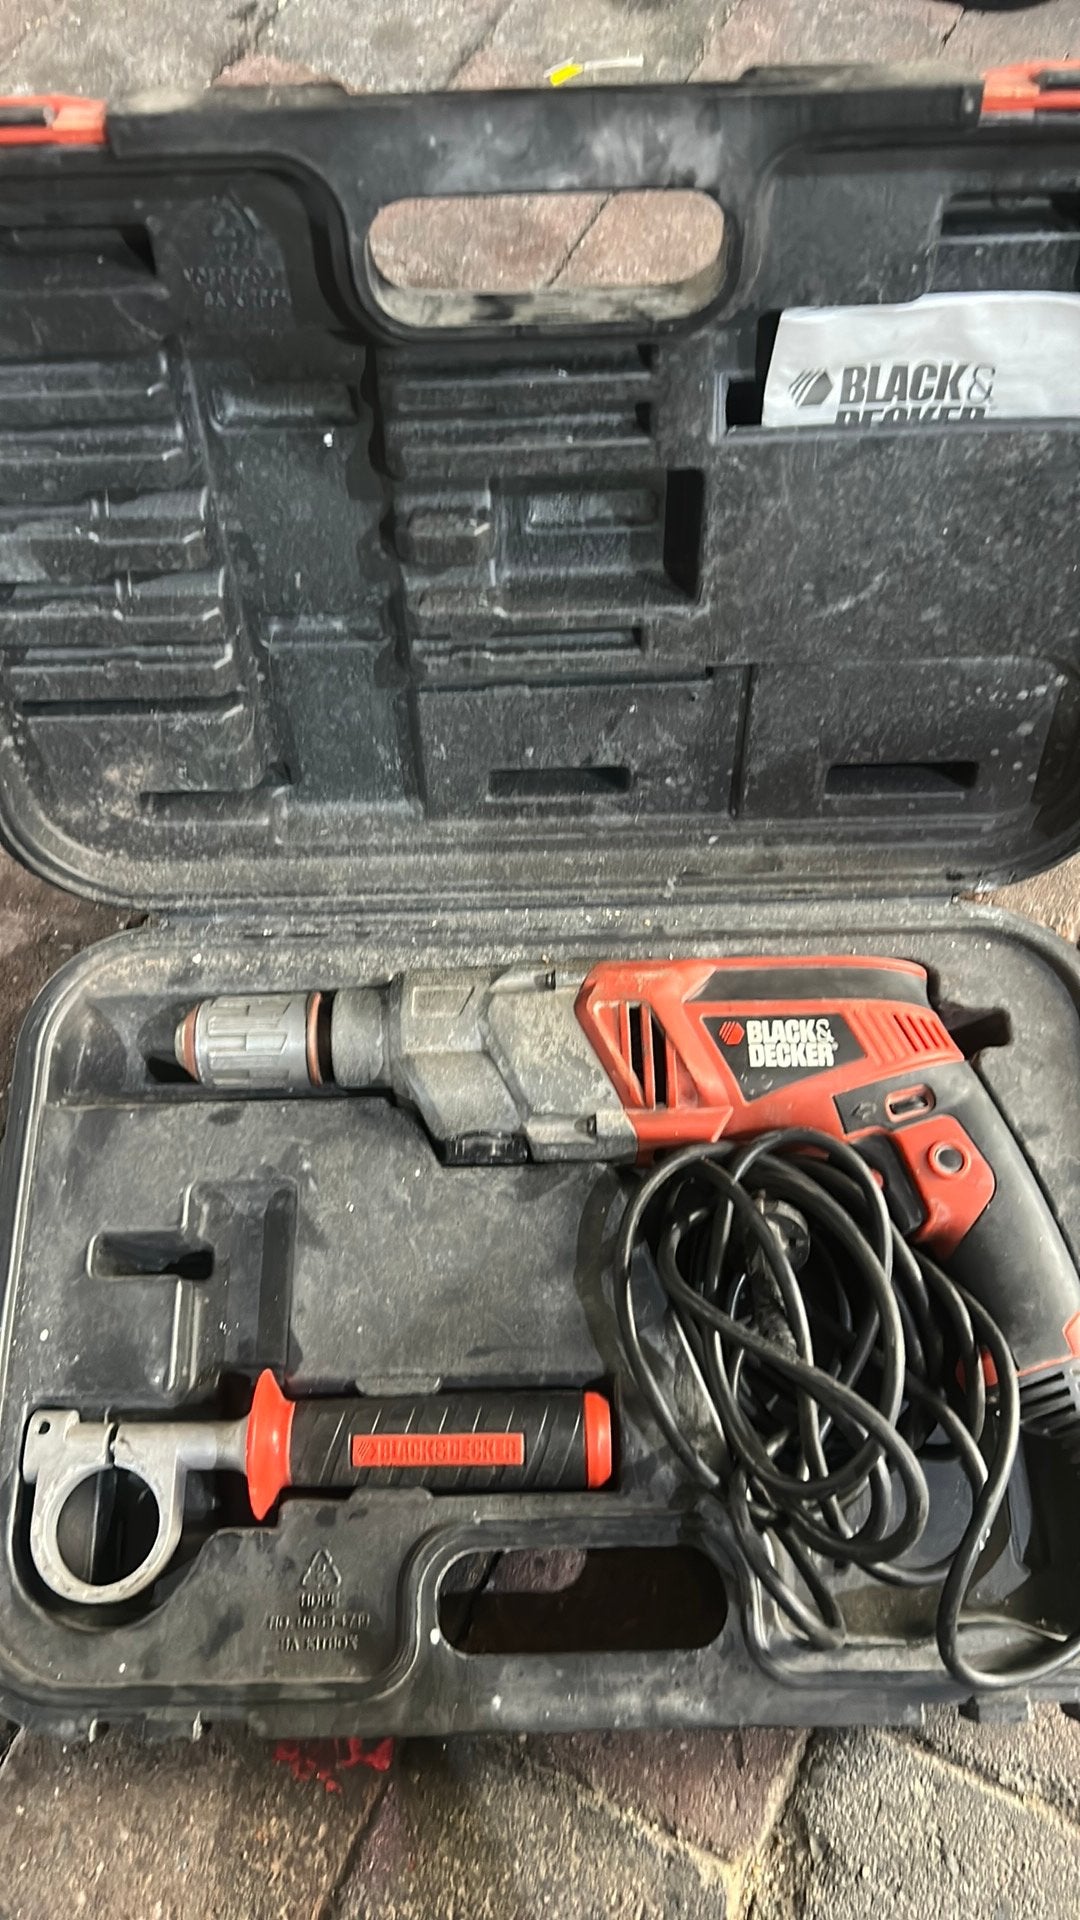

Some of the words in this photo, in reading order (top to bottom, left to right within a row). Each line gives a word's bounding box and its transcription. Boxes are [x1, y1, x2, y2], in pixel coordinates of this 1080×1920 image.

[840, 365, 996, 404] BLACK&
[746, 1018, 835, 1044] BLACK&
[748, 1042, 836, 1068] DECKER
